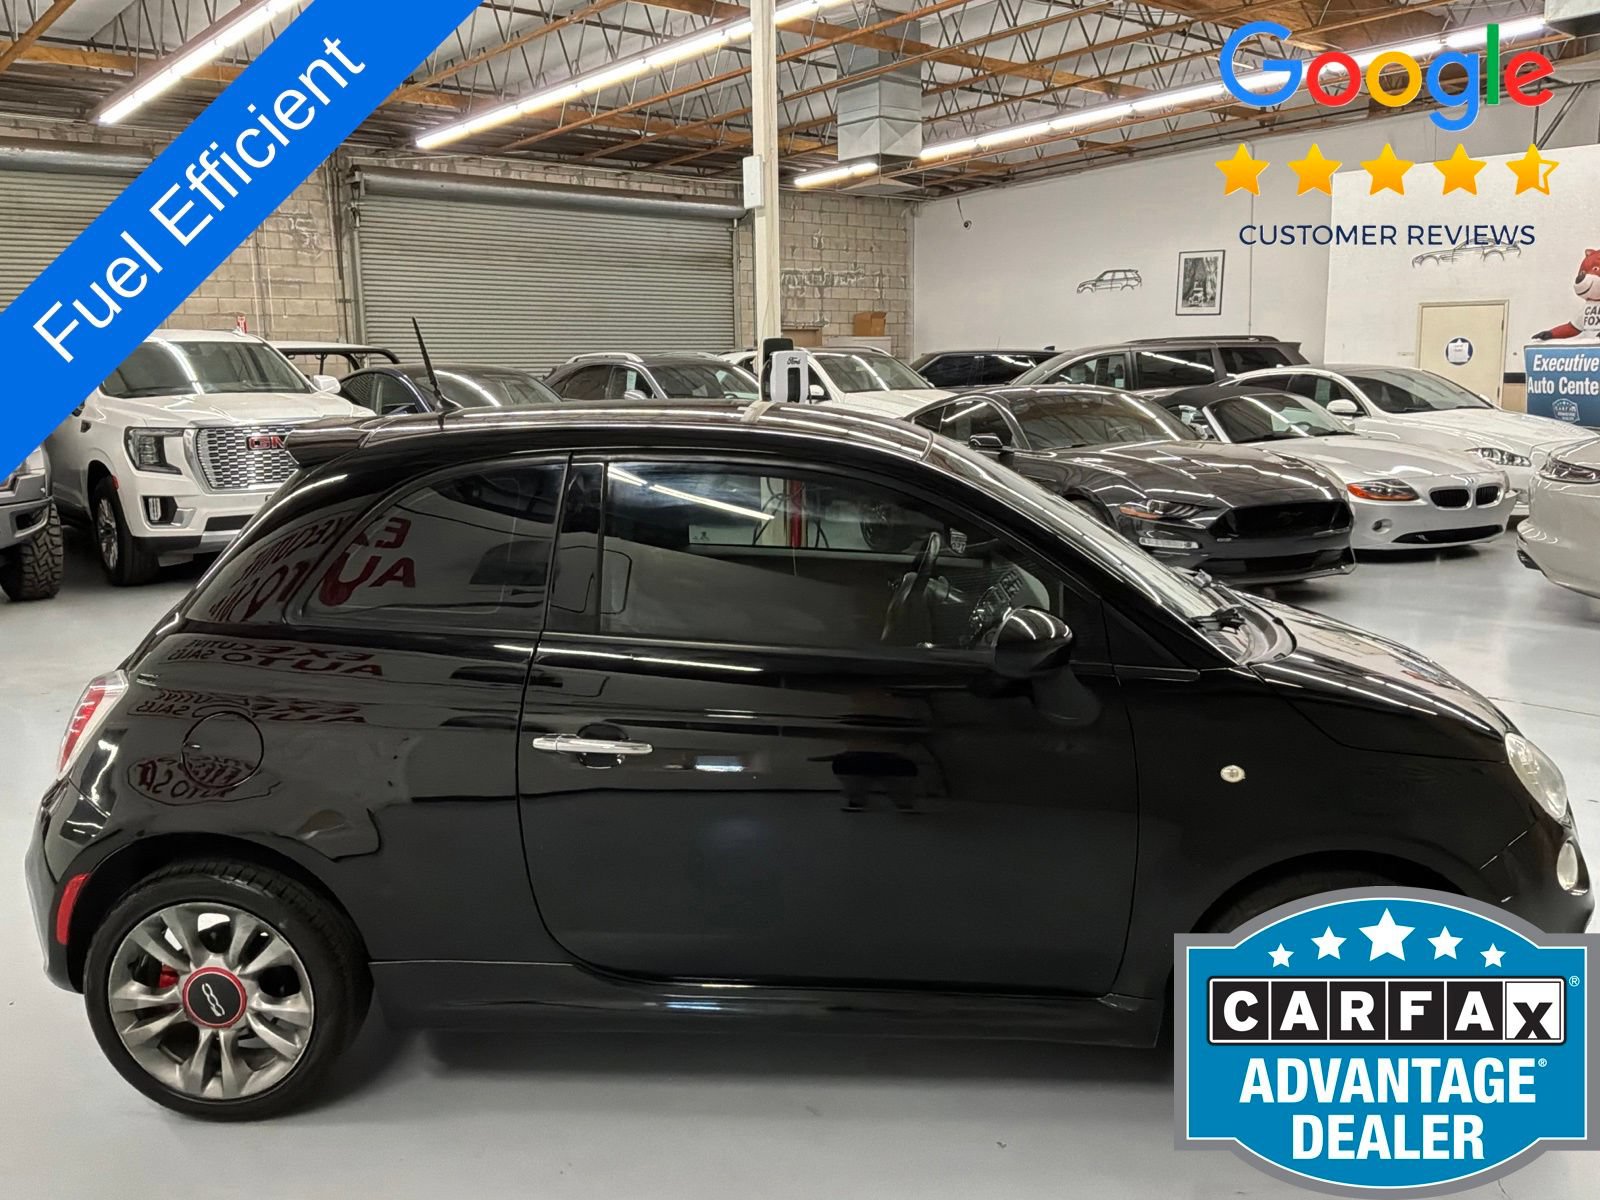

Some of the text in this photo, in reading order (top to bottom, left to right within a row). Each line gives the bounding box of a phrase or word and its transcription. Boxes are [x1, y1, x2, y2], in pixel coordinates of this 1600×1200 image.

[1533, 353, 1600, 372] Executive
[1527, 376, 1600, 396] Auto Cente
[248, 435, 286, 450] GM
